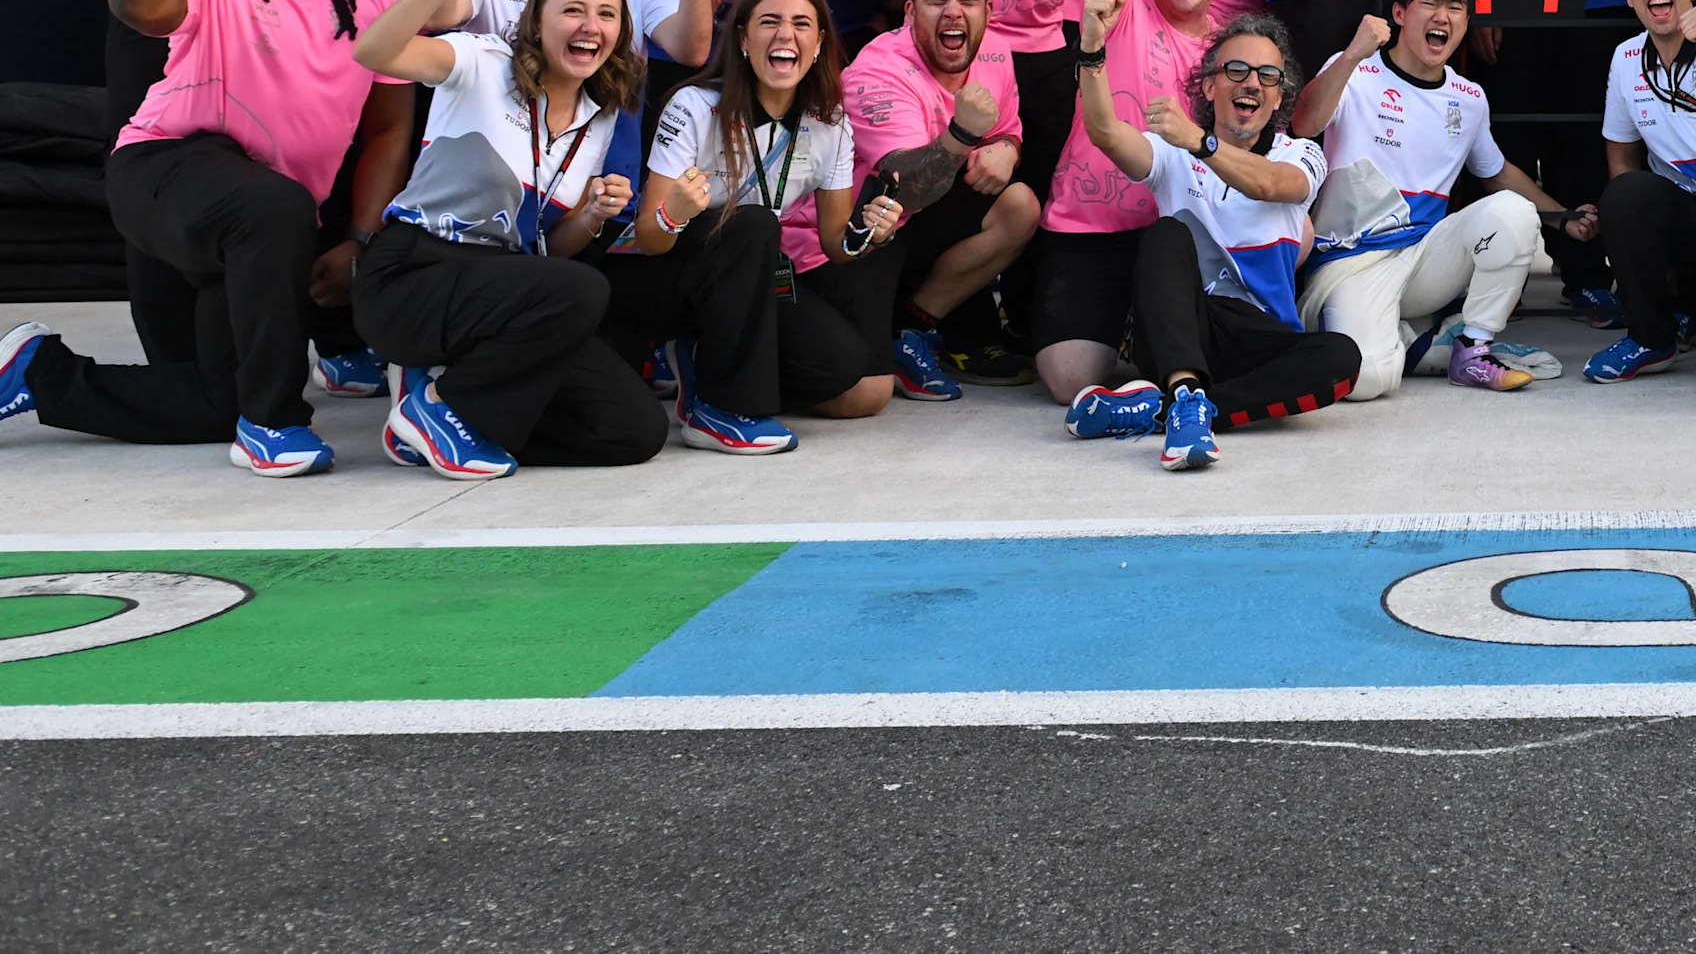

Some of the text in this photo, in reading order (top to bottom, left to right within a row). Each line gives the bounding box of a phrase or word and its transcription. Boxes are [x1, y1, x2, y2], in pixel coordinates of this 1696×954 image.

[1624, 48, 1643, 59] HU
[1451, 81, 1481, 98] HUGO
[1381, 101, 1403, 113] ORLEN
[1377, 113, 1405, 124] HONDA
[1374, 136, 1402, 148] TUDOR
